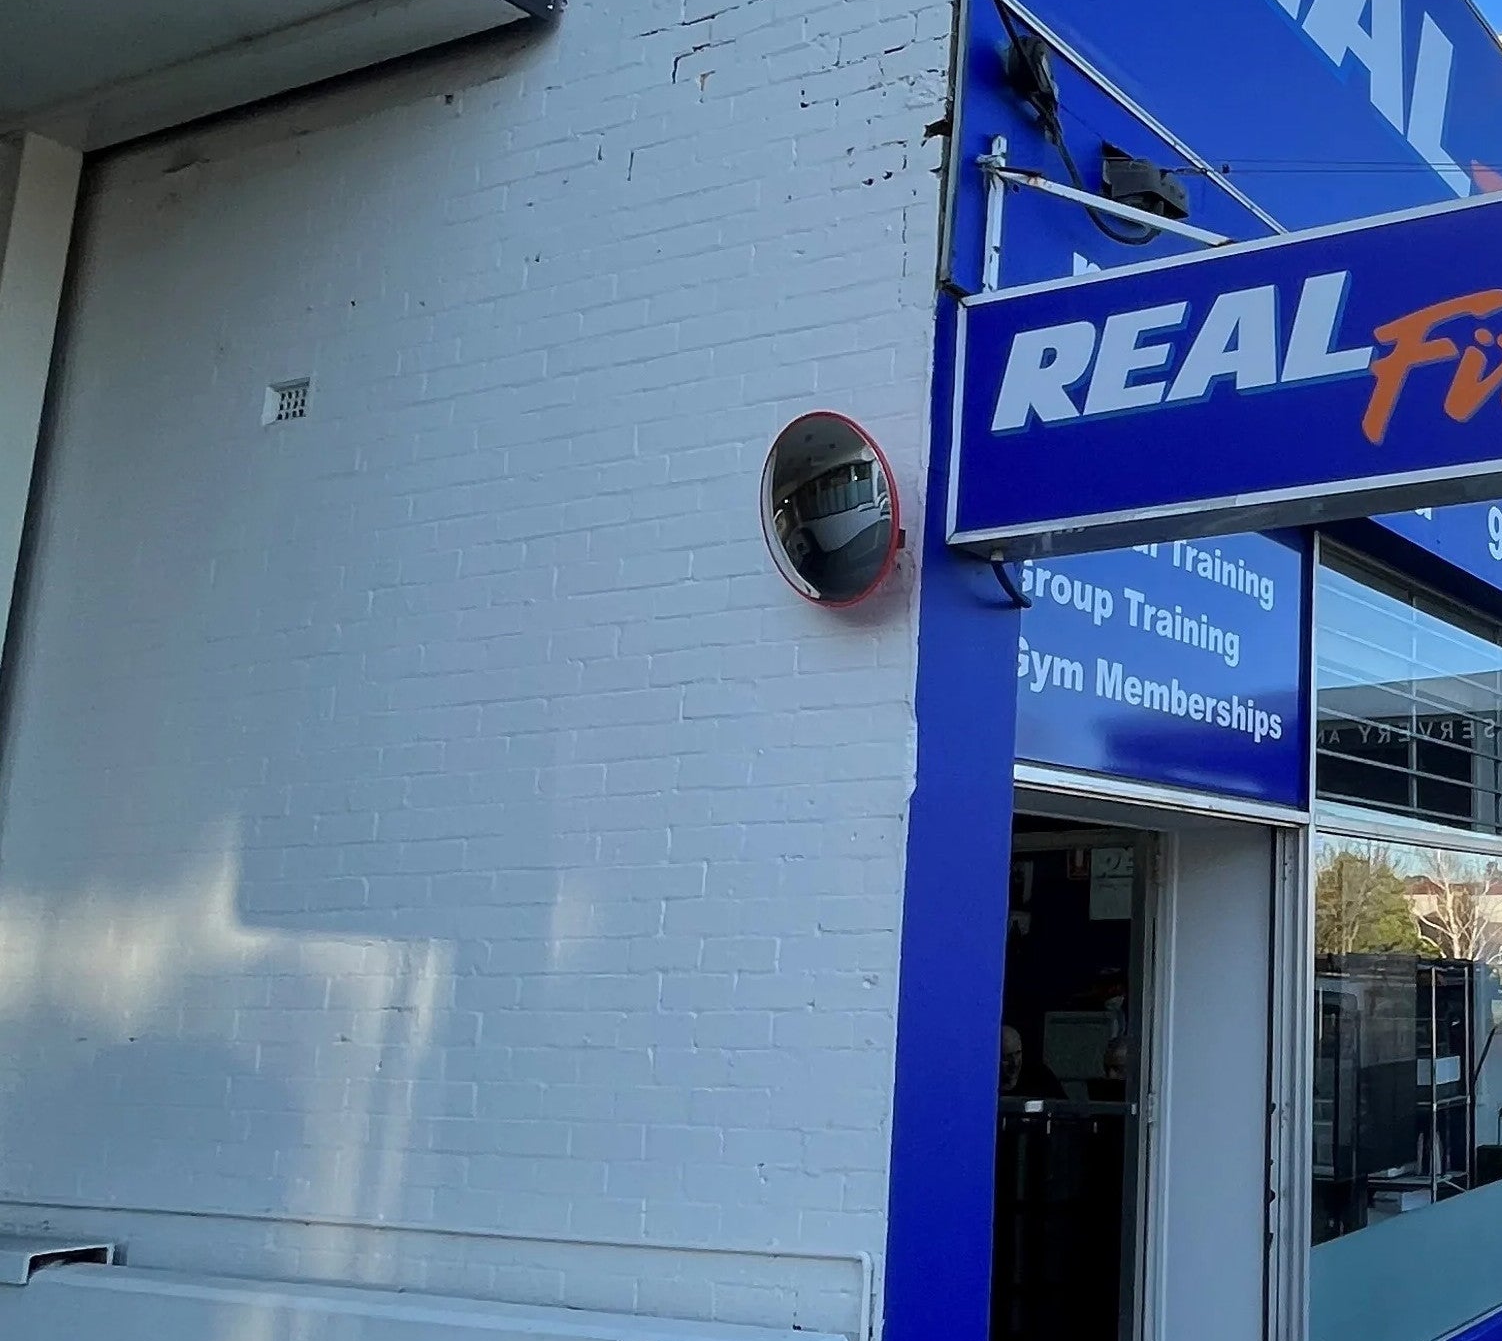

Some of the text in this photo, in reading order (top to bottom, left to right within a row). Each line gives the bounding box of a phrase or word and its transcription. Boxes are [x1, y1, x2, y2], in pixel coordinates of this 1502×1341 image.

[991, 271, 1378, 434] REAL
[1172, 539, 1275, 611] Training
[1124, 587, 1240, 667] Training
[1096, 658, 1282, 743] Memberships
